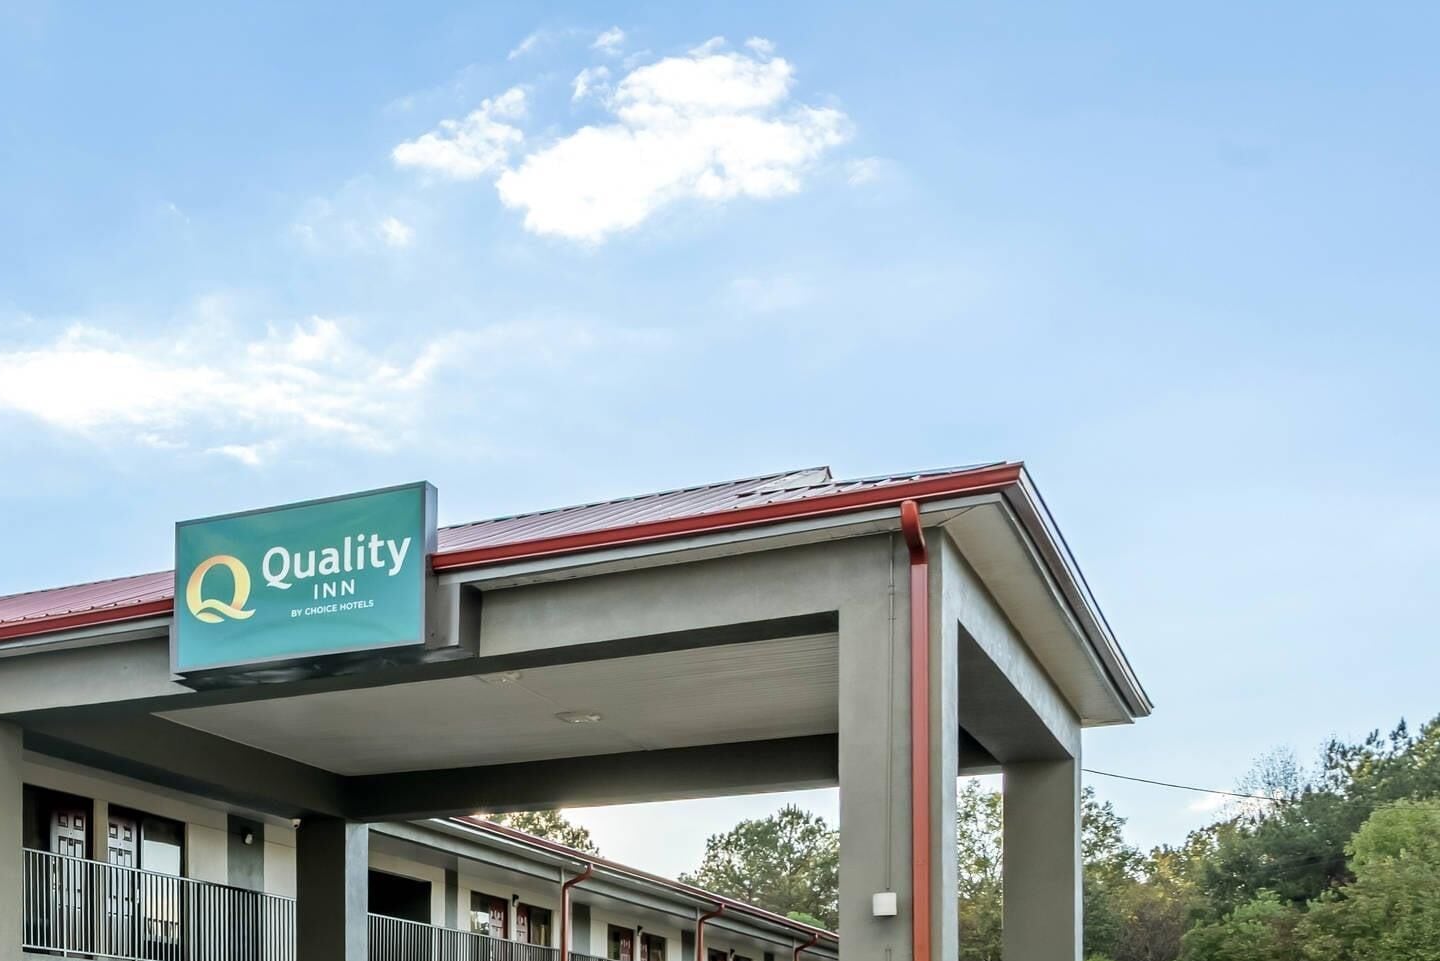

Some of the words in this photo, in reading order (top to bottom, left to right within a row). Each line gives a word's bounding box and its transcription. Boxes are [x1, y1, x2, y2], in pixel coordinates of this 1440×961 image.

[262, 533, 412, 590] Quality
[186, 554, 257, 624] Q
[291, 609, 303, 618] BY
[304, 604, 338, 616] CHOICE
[340, 599, 374, 612] HOTELS
[313, 578, 356, 600] INN
